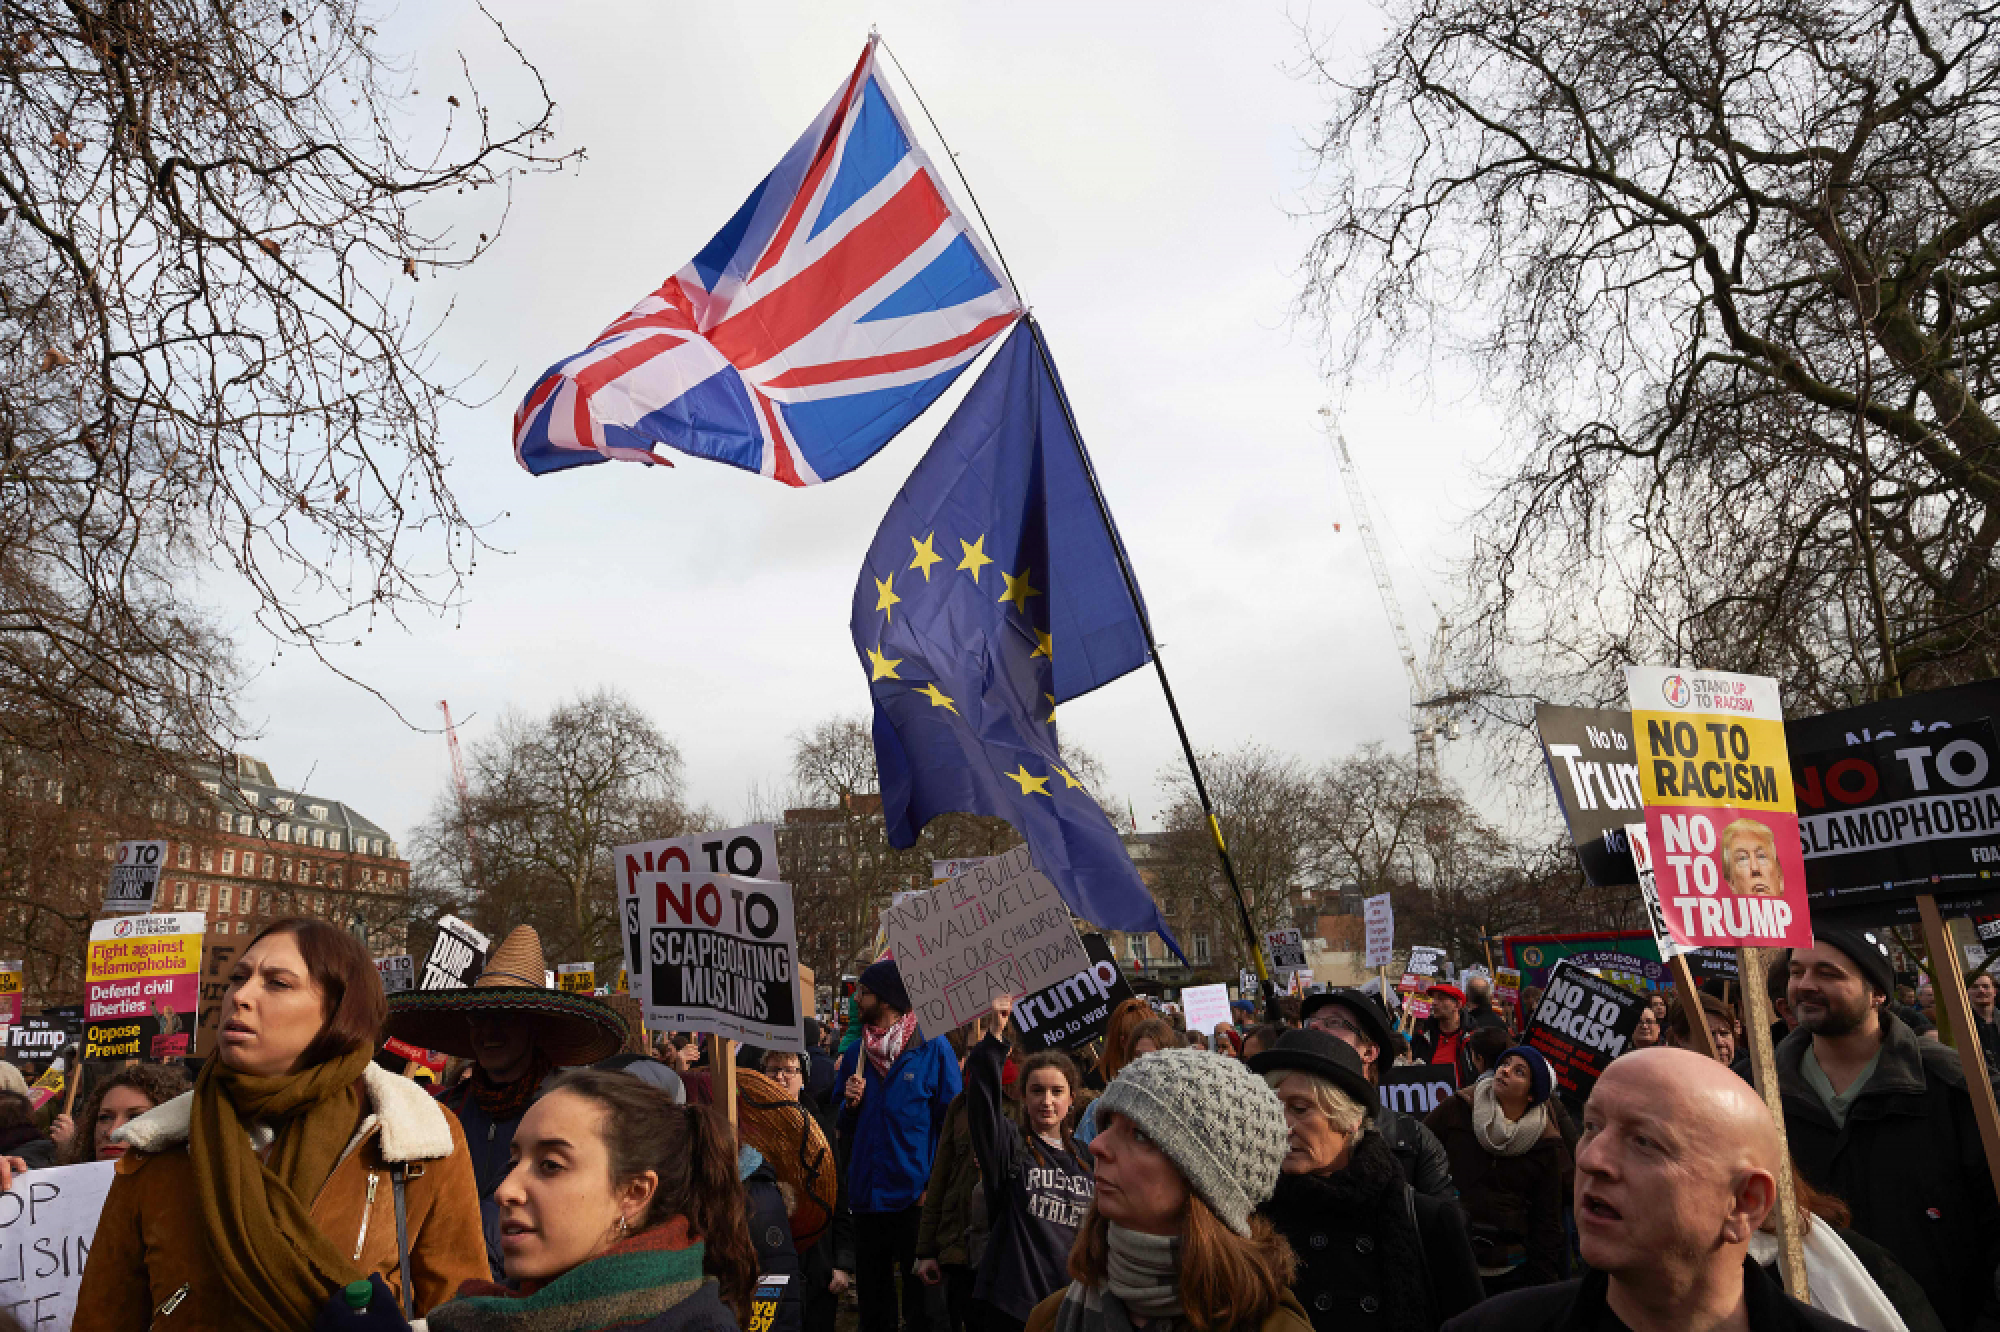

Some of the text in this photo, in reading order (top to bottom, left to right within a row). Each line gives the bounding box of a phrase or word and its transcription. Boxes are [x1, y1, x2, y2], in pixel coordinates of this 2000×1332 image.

[1692, 679, 1747, 696] STAND UP
[1695, 693, 1755, 712] TO RACISM
[1586, 725, 1629, 751] No to
[1647, 719, 1751, 761] NO TO
[1548, 744, 1645, 811] Trum
[1653, 760, 1779, 803] RACISM
[1894, 738, 1989, 791] TO
[1602, 828, 1627, 854] No
[1660, 813, 1717, 854] NO
[1797, 793, 2000, 856] SLAMOPHOBIA
[135, 844, 160, 865] TO
[625, 835, 763, 895] NO TO
[886, 897, 929, 940] AND
[947, 872, 976, 907] HE
[973, 848, 1033, 896] BUILD
[1666, 855, 1719, 895] TO
[655, 881, 723, 928] NO
[730, 888, 779, 939] TO
[1673, 897, 1793, 939] TRUMP
[92, 939, 185, 961] Fight against
[429, 929, 475, 979] DUMP
[651, 931, 790, 983] SCAPEGOATING
[897, 941, 917, 972] A
[903, 904, 1070, 1001] RAISE OUR CHILDREN
[1268, 932, 1287, 946] NO
[91, 955, 187, 976] Islamophobia
[394, 957, 411, 969] TO
[89, 997, 147, 1018] liberties
[90, 979, 174, 1001] Defend civil
[681, 966, 769, 1021] MUSLIMS
[916, 999, 945, 1027] TO
[947, 959, 1024, 1014] TEAR
[1015, 951, 1037, 983] IT
[1547, 977, 1585, 1009] NO
[1588, 993, 1620, 1027] TO
[10, 1025, 65, 1050] Trump
[29, 1019, 41, 1028] No
[87, 1023, 142, 1043] Oppose
[1043, 1029, 1065, 1047] No
[1065, 1019, 1081, 1034] to
[1081, 1003, 1109, 1025] war
[1536, 999, 1627, 1059] RACISM
[85, 1038, 141, 1059] Prevent
[747, 1315, 775, 1332] AG
[751, 1301, 779, 1317] RA
